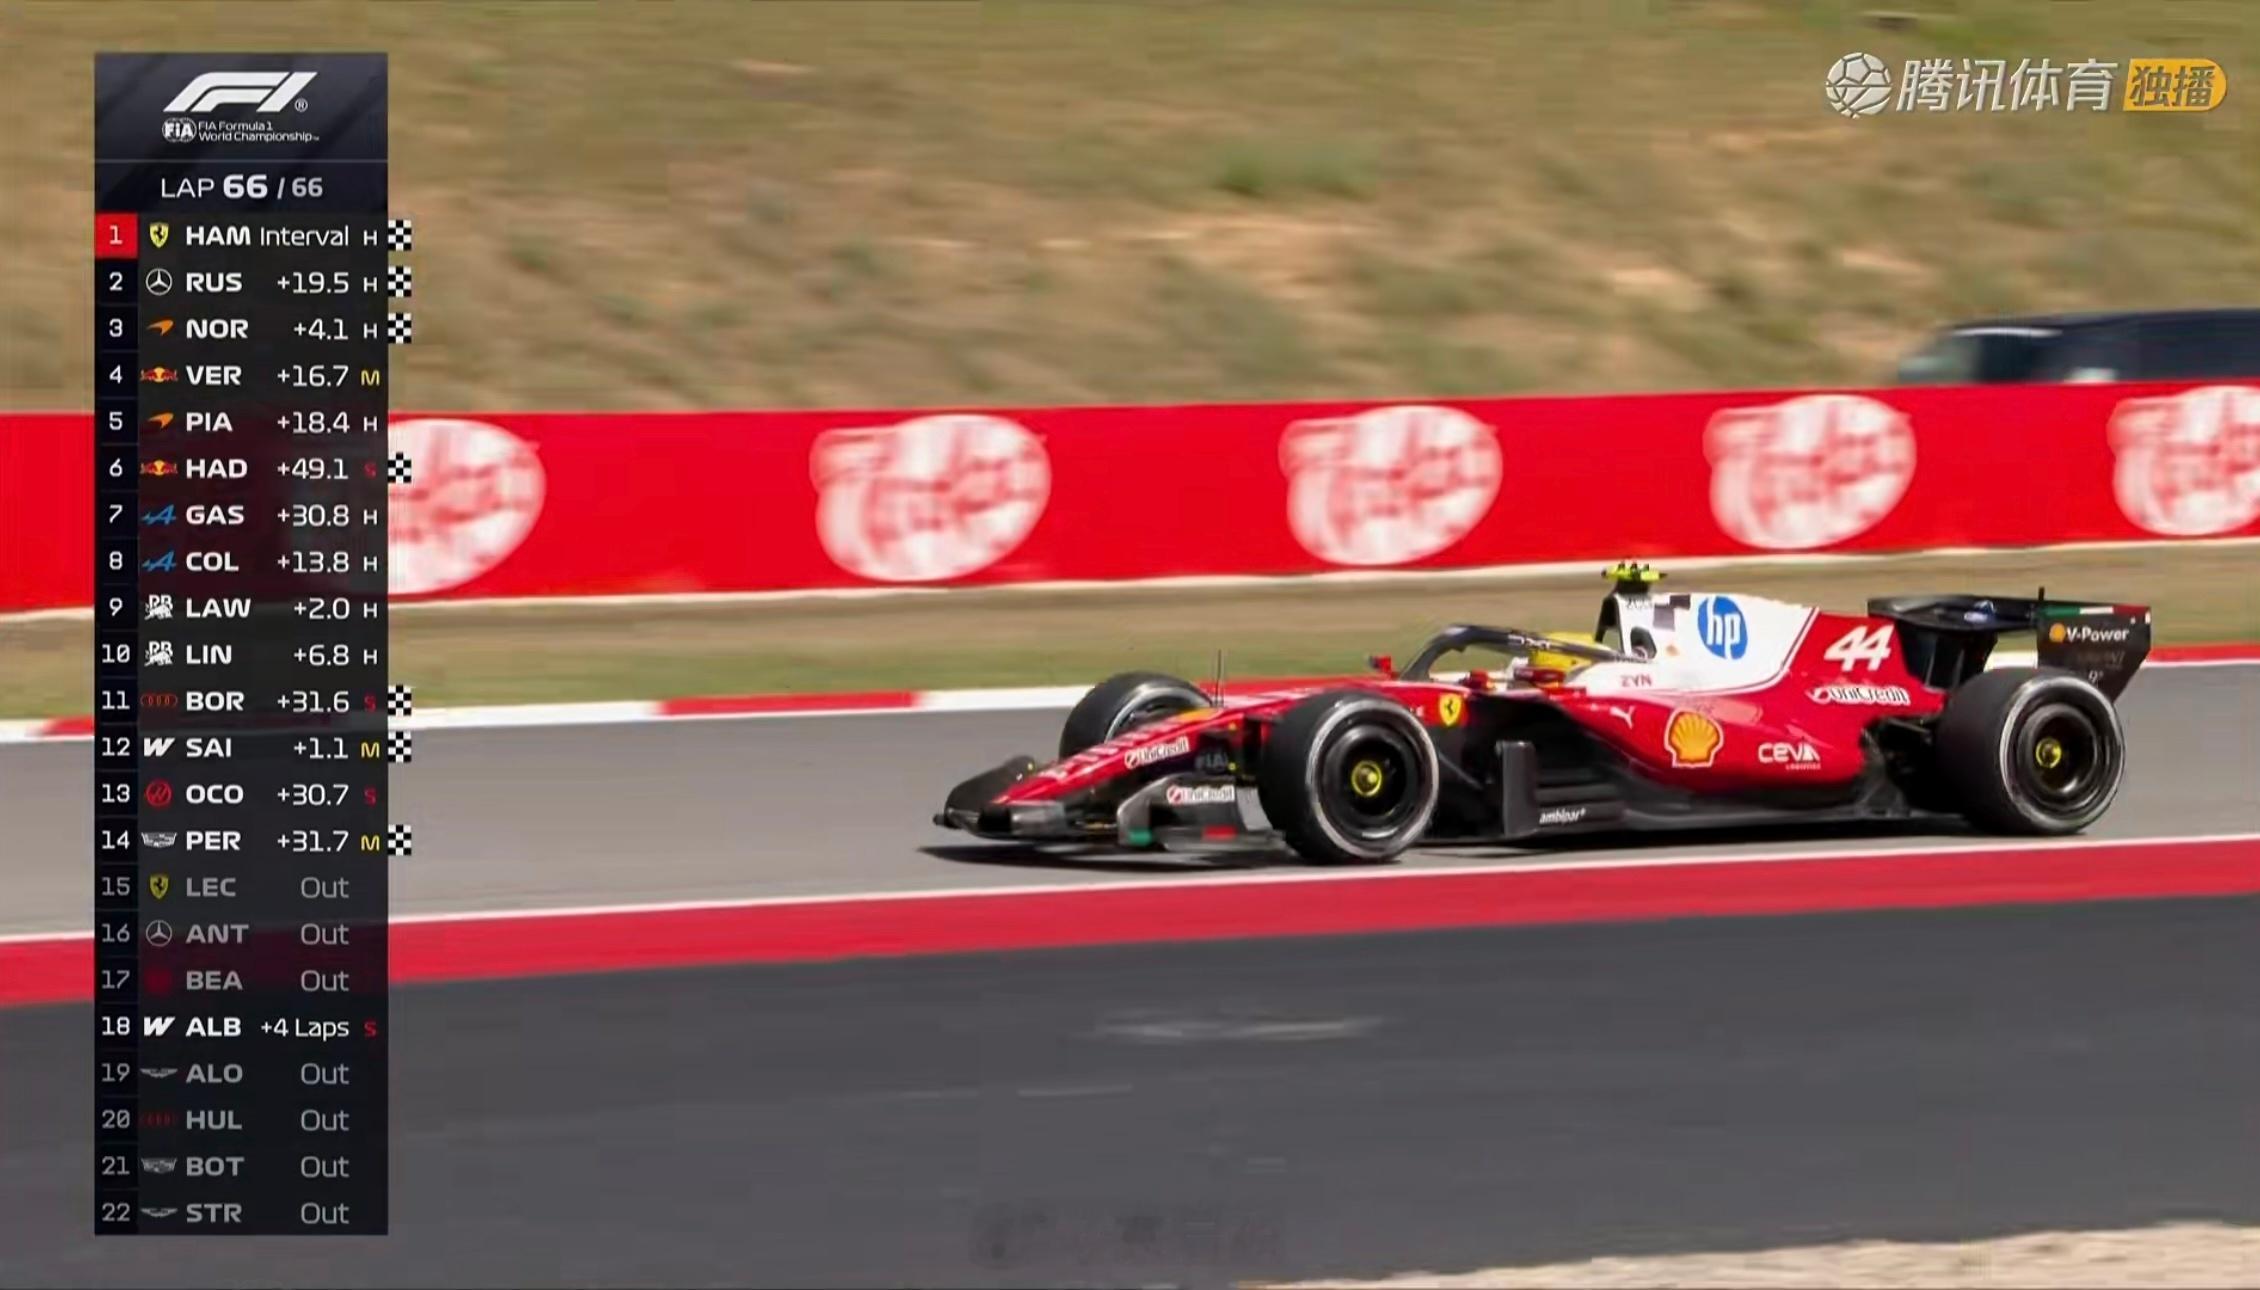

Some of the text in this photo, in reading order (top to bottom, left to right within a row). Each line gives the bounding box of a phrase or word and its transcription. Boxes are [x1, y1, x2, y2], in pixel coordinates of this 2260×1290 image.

[1704, 597, 1743, 660] hp
[2066, 626, 2130, 642] V-Power
[1824, 624, 1894, 671] 44
[1758, 741, 1821, 763] CEVA
